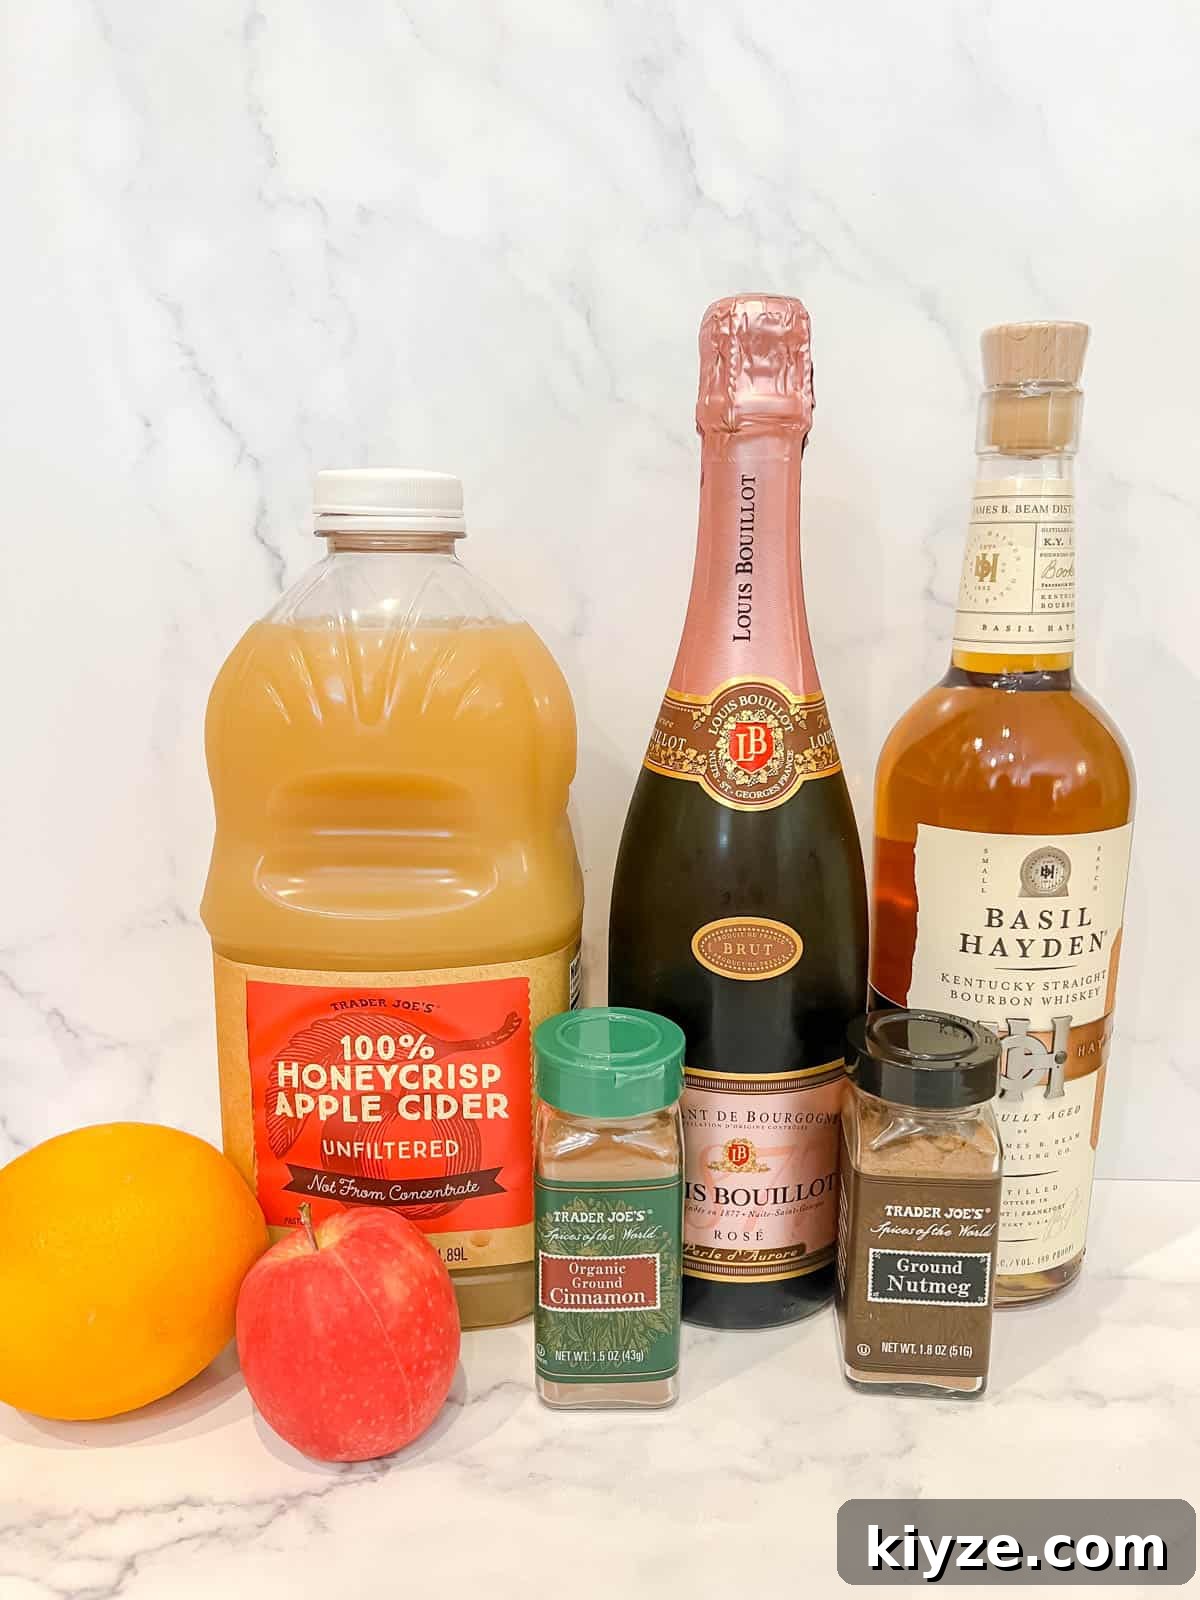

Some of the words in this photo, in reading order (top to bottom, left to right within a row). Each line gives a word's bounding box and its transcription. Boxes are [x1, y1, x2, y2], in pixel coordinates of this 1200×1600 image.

[973, 504, 999, 515] AMES
[1015, 504, 1049, 514] BEAM
[735, 474, 756, 575] BOUILLOT
[732, 583, 752, 643] LOUIS
[982, 624, 1034, 633] BASIL
[708, 698, 739, 736] LOUIS
[738, 695, 795, 732] BOUILLOT
[736, 725, 767, 762] LB
[981, 848, 989, 893] SMALL
[984, 907, 1092, 930] BASIL
[723, 942, 773, 955] BRUT
[959, 930, 1104, 958] HAYDEN
[941, 973, 1035, 991] KENTUCKY
[1043, 969, 1107, 991] STRAIGHT
[330, 998, 387, 1012] TRADER
[392, 1000, 435, 1013] JOE'S
[951, 990, 1032, 1006] BOURBON
[1042, 987, 1100, 1006] WHISKEY
[340, 1034, 435, 1061] 100%
[277, 1061, 501, 1090] HONEYCRISP
[275, 1092, 382, 1122] APPLE
[397, 1094, 509, 1120] CIDER
[717, 1111, 738, 1122] DE
[996, 1112, 1040, 1122] ULLY
[1048, 1104, 1081, 1120] AGED
[322, 1139, 459, 1160] UNFILTERED
[307, 1174, 336, 1194] Not
[339, 1177, 386, 1201] From
[389, 1181, 480, 1201] Concentrate
[713, 1173, 838, 1207] BOUILLOT
[553, 1211, 605, 1223] TRADER
[607, 1210, 646, 1223] JOE'S
[884, 1204, 941, 1218] TRADER
[944, 1207, 984, 1220] JOE'S
[544, 1228, 581, 1244] Spices
[582, 1228, 601, 1246] of
[597, 1228, 615, 1241] the
[623, 1225, 662, 1241] World
[713, 1228, 764, 1242] ROSÉ
[870, 1221, 915, 1239] Spices
[915, 1223, 938, 1241] of
[931, 1223, 952, 1237] the
[959, 1222, 997, 1238] World
[569, 1261, 626, 1276] Organic
[896, 1258, 963, 1275] Ground
[572, 1276, 623, 1289] Ground
[887, 1274, 972, 1298] Nutmeg
[550, 1288, 645, 1305] Cinnamon
[555, 1350, 571, 1361] NET
[592, 1351, 605, 1361] 1.5
[607, 1350, 619, 1361] OZ
[622, 1349, 644, 1362] (43g)
[881, 1342, 898, 1353] NET
[900, 1343, 917, 1355] WT.
[920, 1344, 933, 1355] 1.8
[935, 1344, 947, 1356] OZ
[949, 1344, 973, 1359] (51G)
